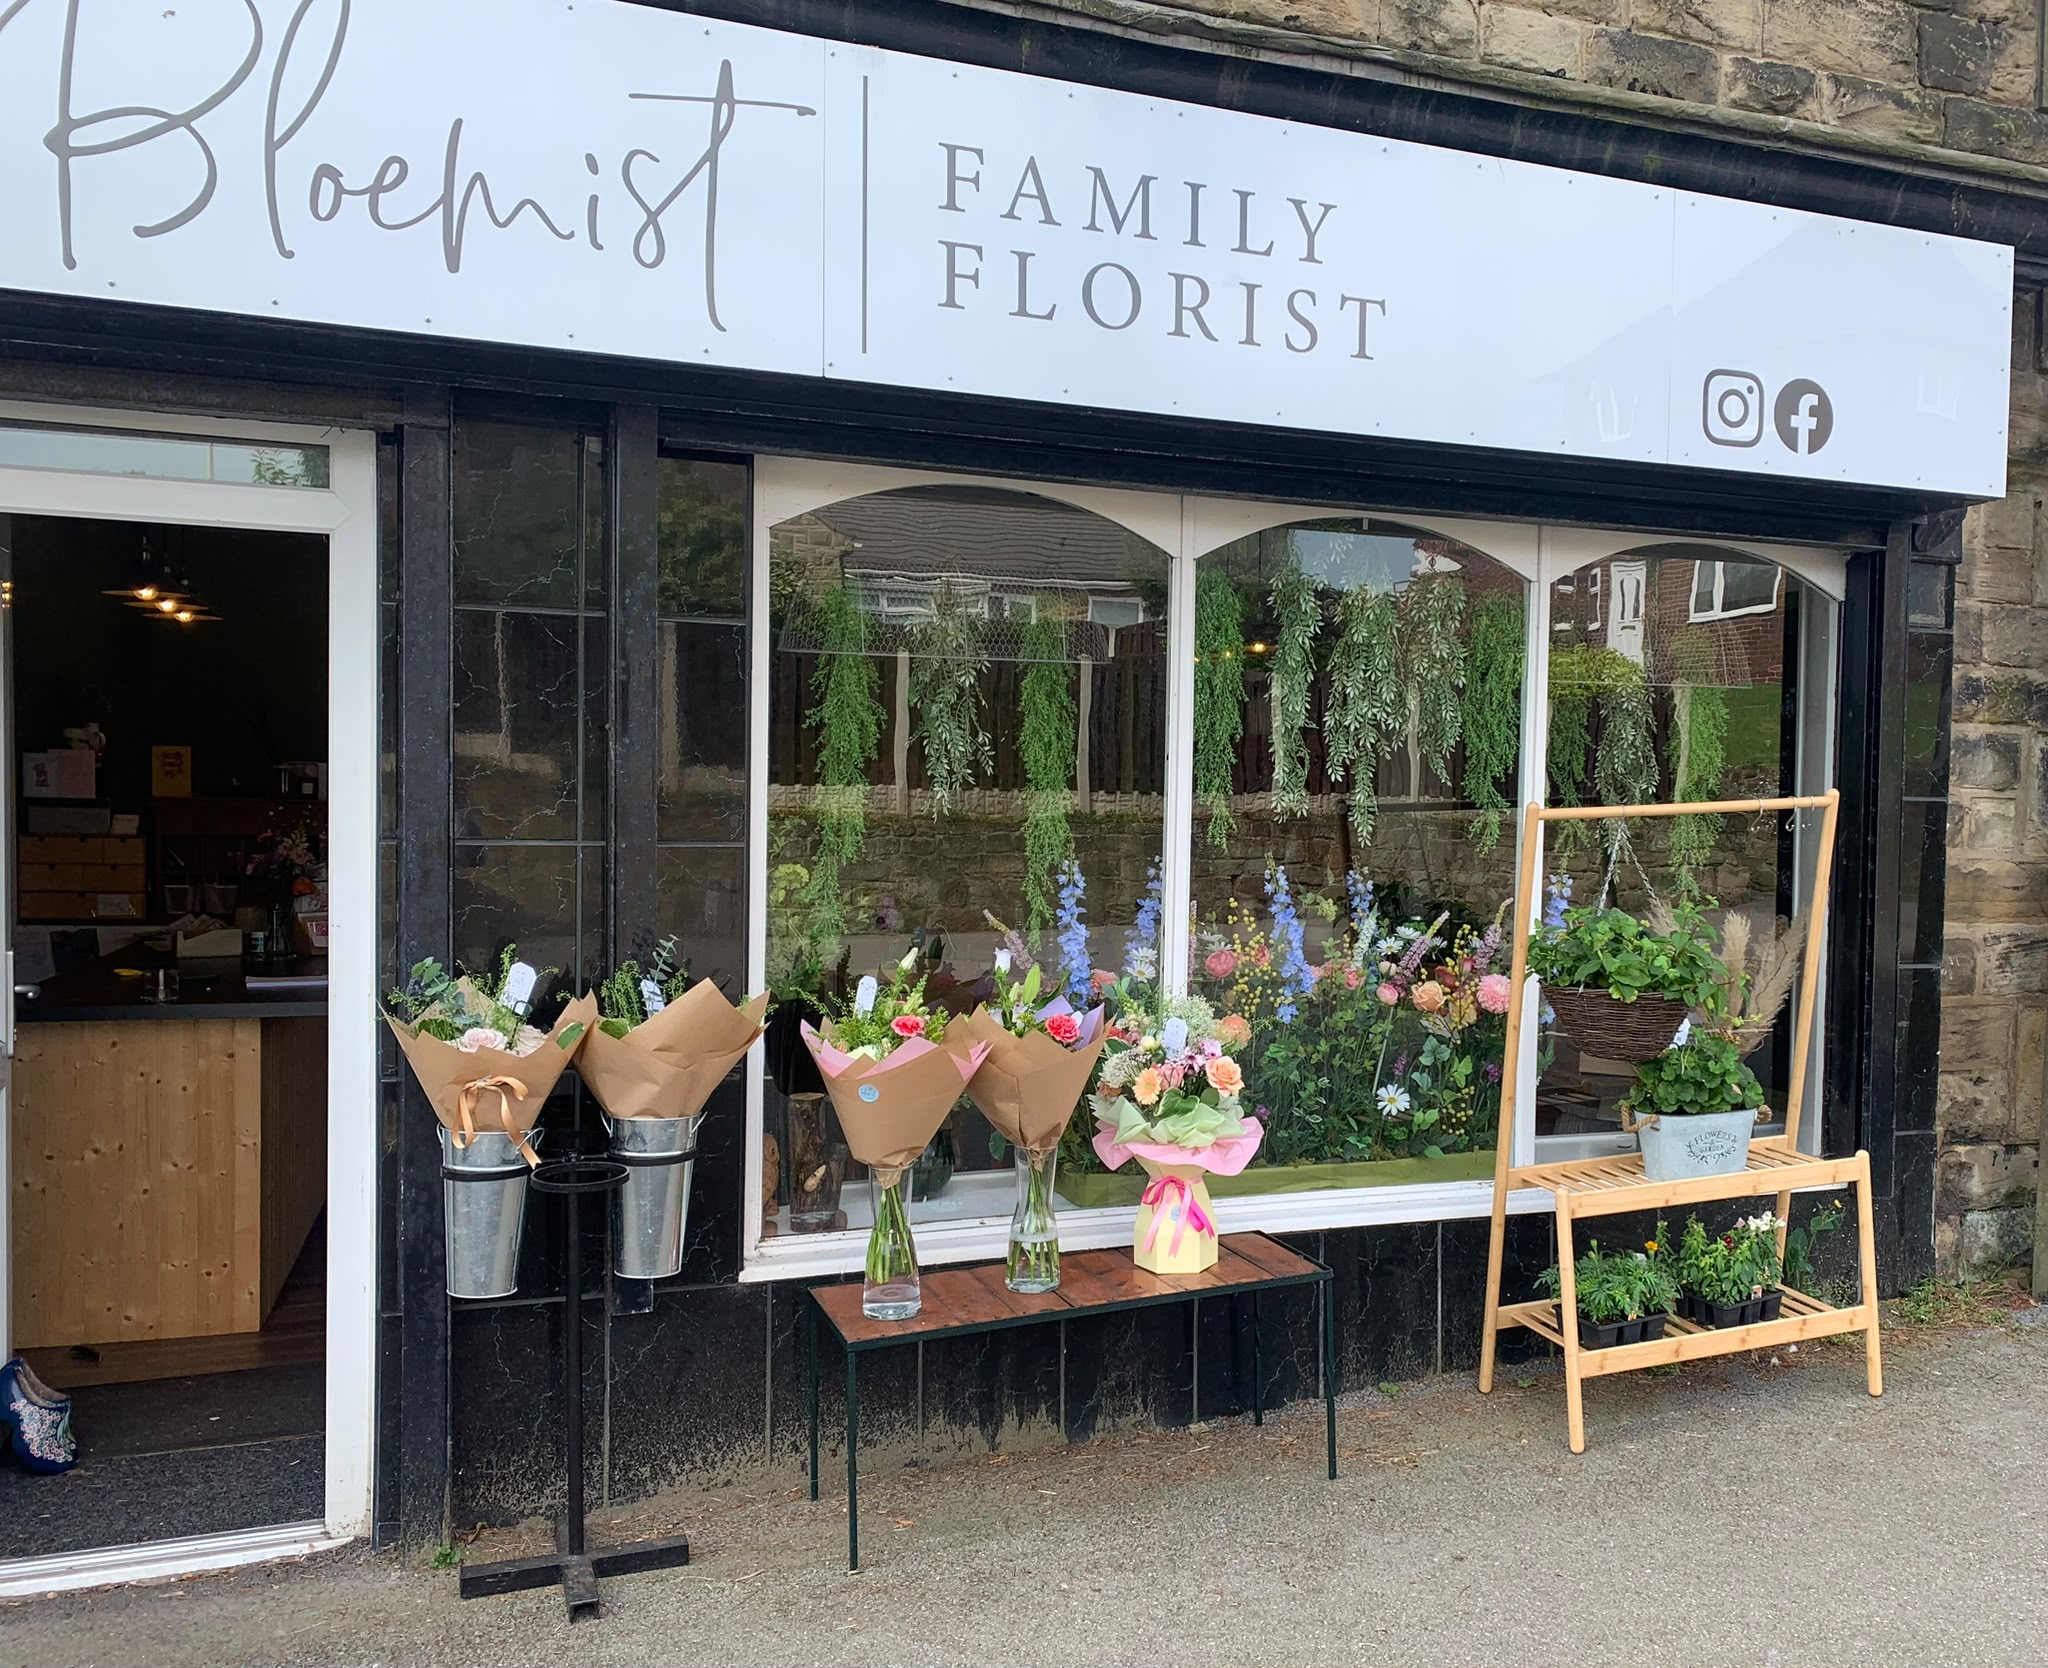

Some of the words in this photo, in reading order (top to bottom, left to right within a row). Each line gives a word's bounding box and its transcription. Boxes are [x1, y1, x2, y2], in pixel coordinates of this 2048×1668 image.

[0, 0, 817, 332] Bloemist
[937, 141, 1338, 265] FAMILY
[936, 239, 1387, 361] FLORIST
[1694, 1130, 1732, 1145] FLOWERS
